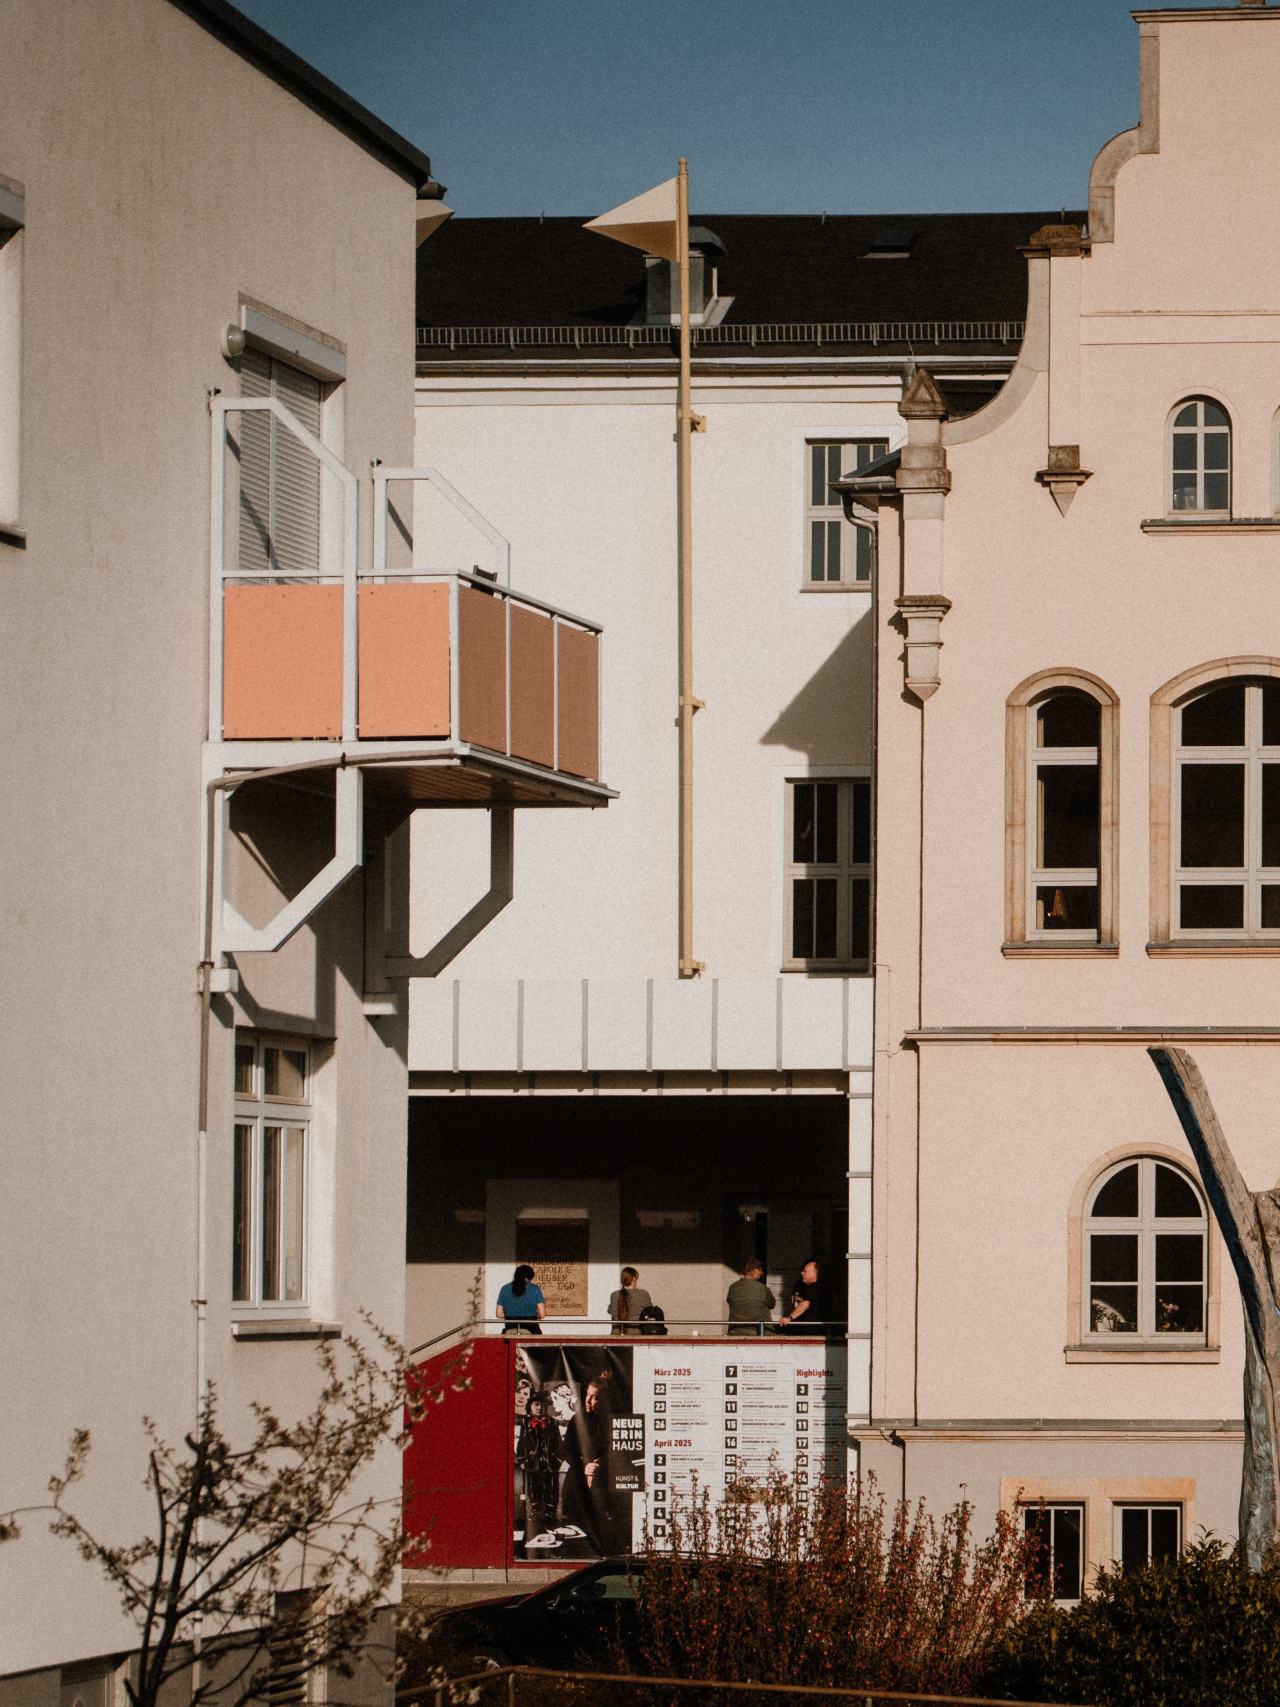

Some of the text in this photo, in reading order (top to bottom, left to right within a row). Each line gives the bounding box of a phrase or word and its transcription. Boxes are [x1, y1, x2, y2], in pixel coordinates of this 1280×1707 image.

[654, 1368, 692, 1376] März 2025
[728, 1367, 734, 1376] 7
[796, 1368, 834, 1378] Highlights
[655, 1385, 665, 1393] 22
[728, 1385, 734, 1393] 9
[800, 1386, 805, 1394] 3
[655, 1403, 665, 1411] 23
[726, 1403, 736, 1411] 11
[798, 1403, 807, 1412] 10
[612, 1419, 642, 1428] NEUB
[655, 1421, 665, 1429] 26
[726, 1421, 736, 1429] 15
[798, 1421, 807, 1429] 11
[612, 1430, 642, 1440] ERIN
[612, 1441, 643, 1451] HAUS
[654, 1440, 672, 1448] April
[726, 1438, 736, 1447] 16
[798, 1439, 807, 1447] 17
[657, 1456, 662, 1464] 2
[657, 1474, 662, 1482] 2
[657, 1509, 662, 1517] 4
[657, 1527, 662, 1535] 6
